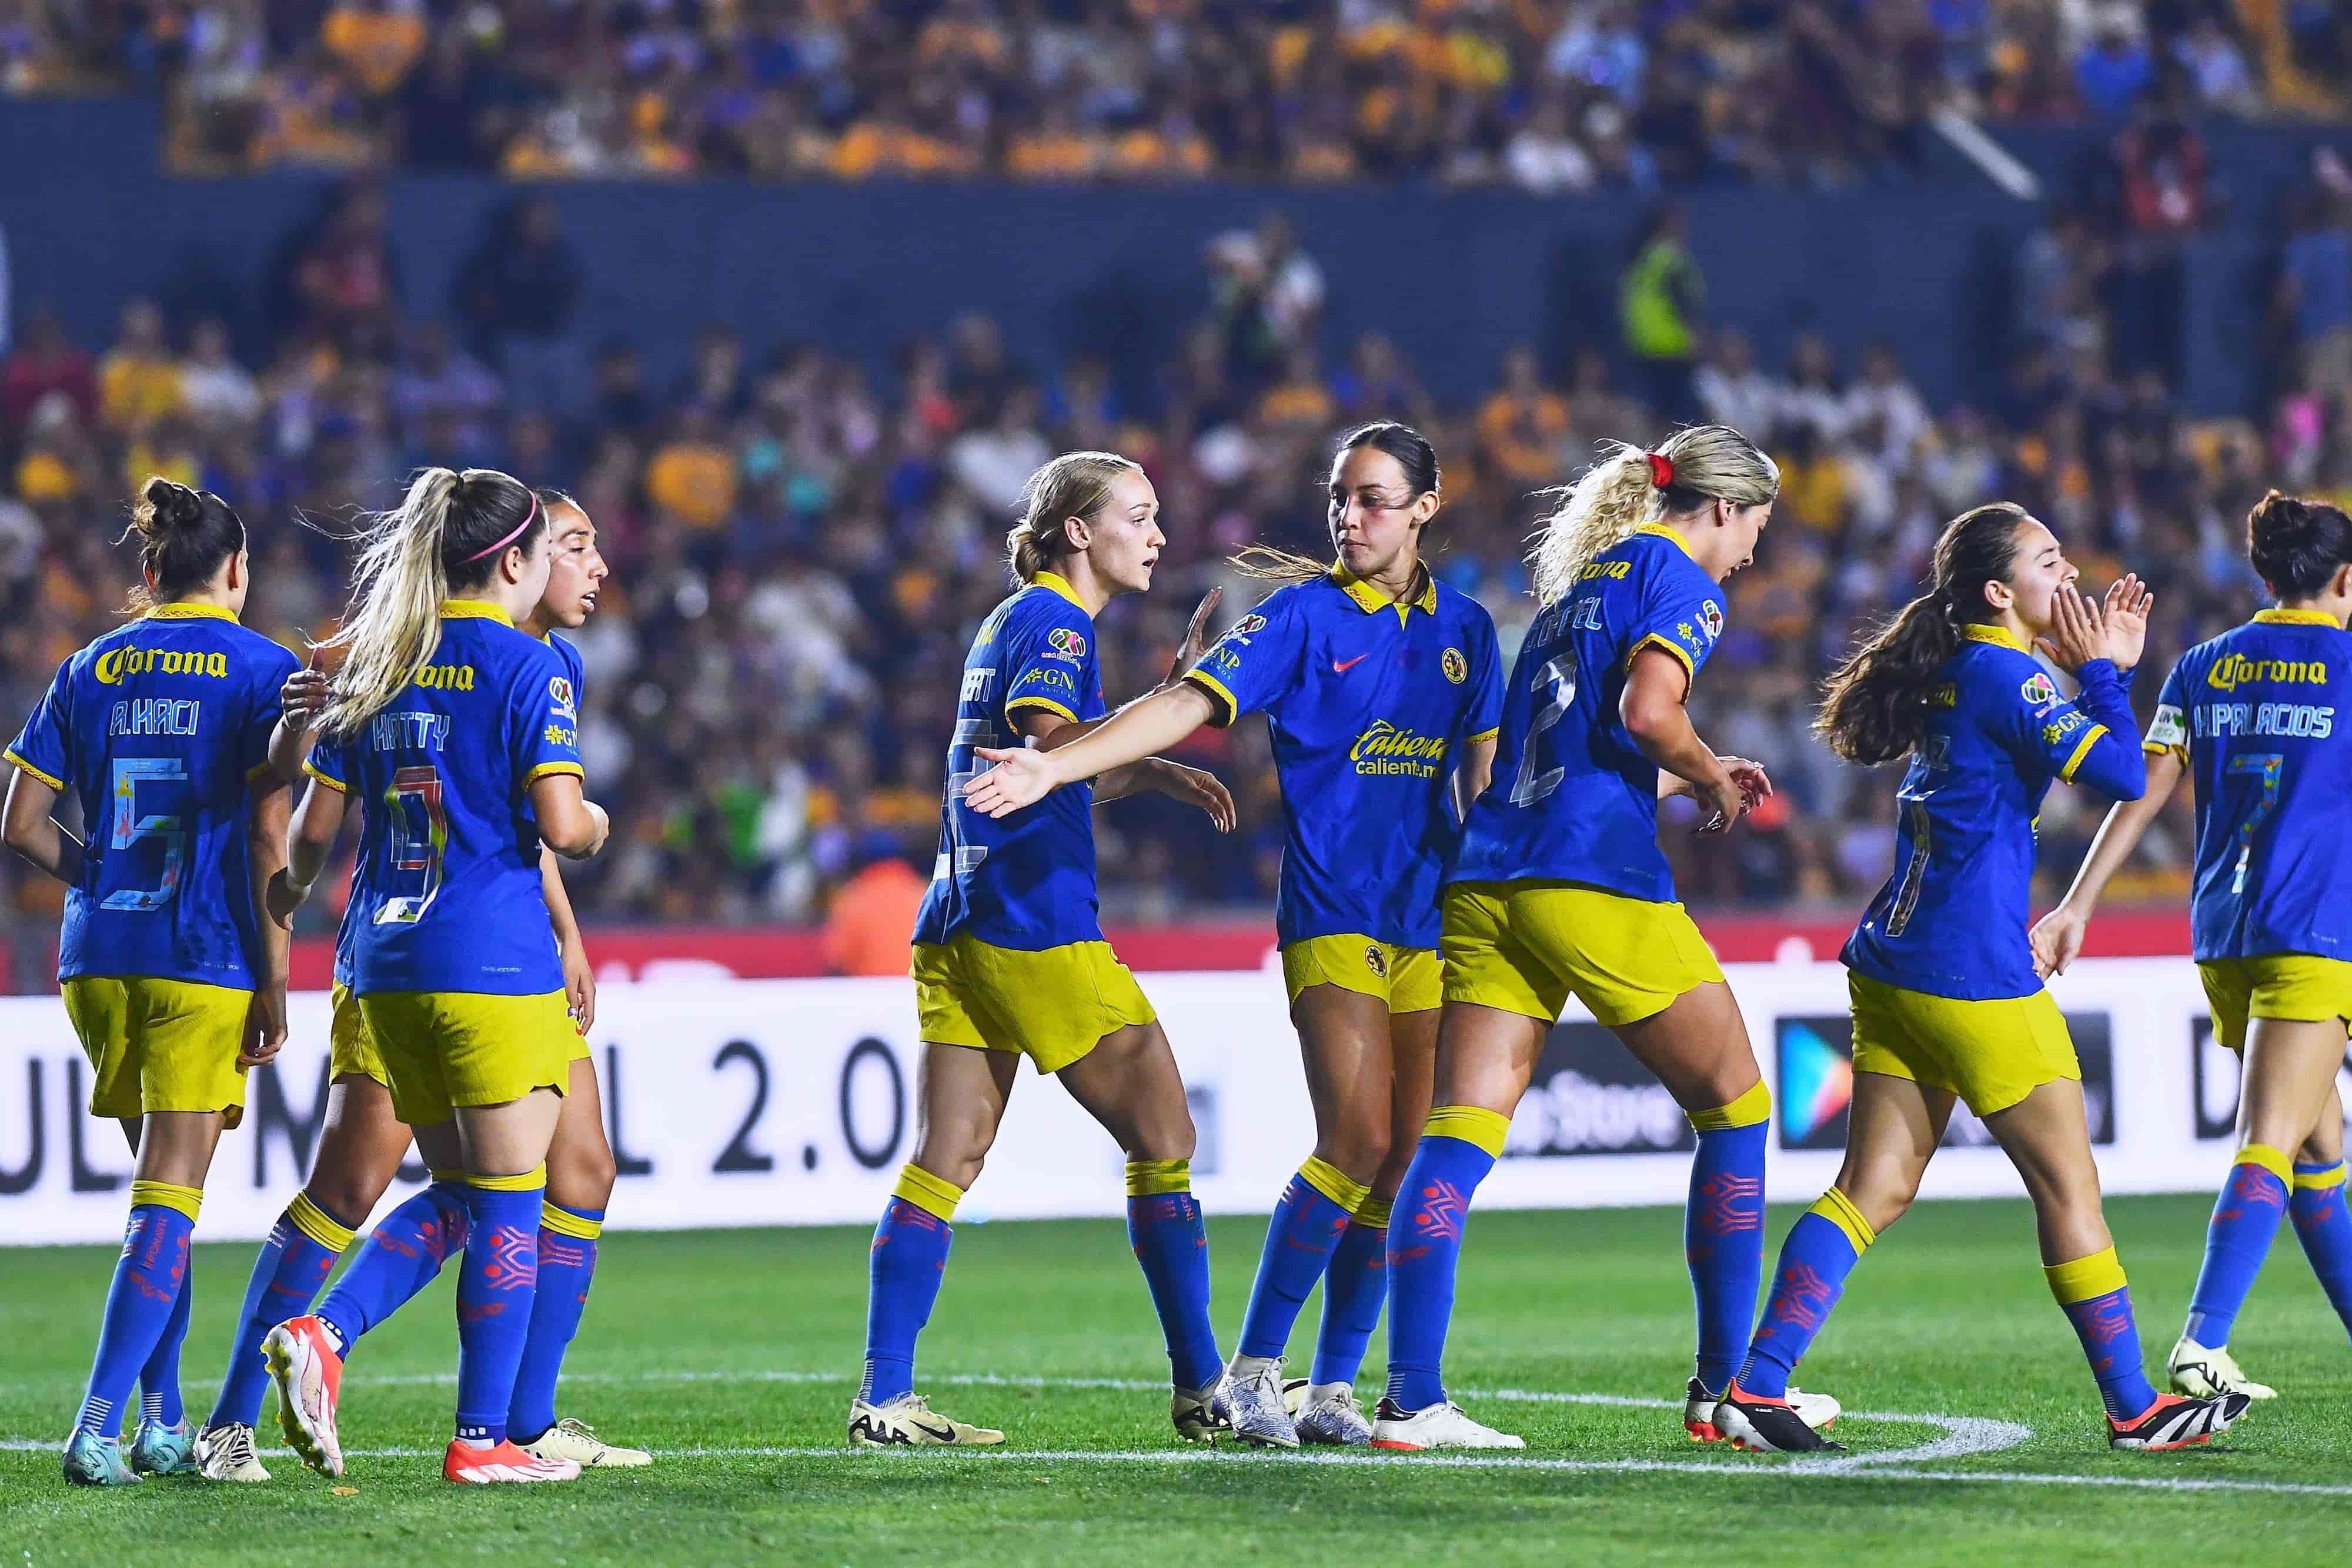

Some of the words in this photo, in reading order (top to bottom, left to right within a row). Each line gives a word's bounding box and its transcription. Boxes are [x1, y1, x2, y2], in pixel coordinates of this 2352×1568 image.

[95, 644, 228, 686] Corona
[1509, 649, 1578, 808] 2
[2207, 653, 2327, 693] Corona
[99, 758, 188, 911] 5
[375, 765, 447, 924] 9
[2227, 754, 2283, 894] 7
[713, 1037, 904, 1172] 2.0
